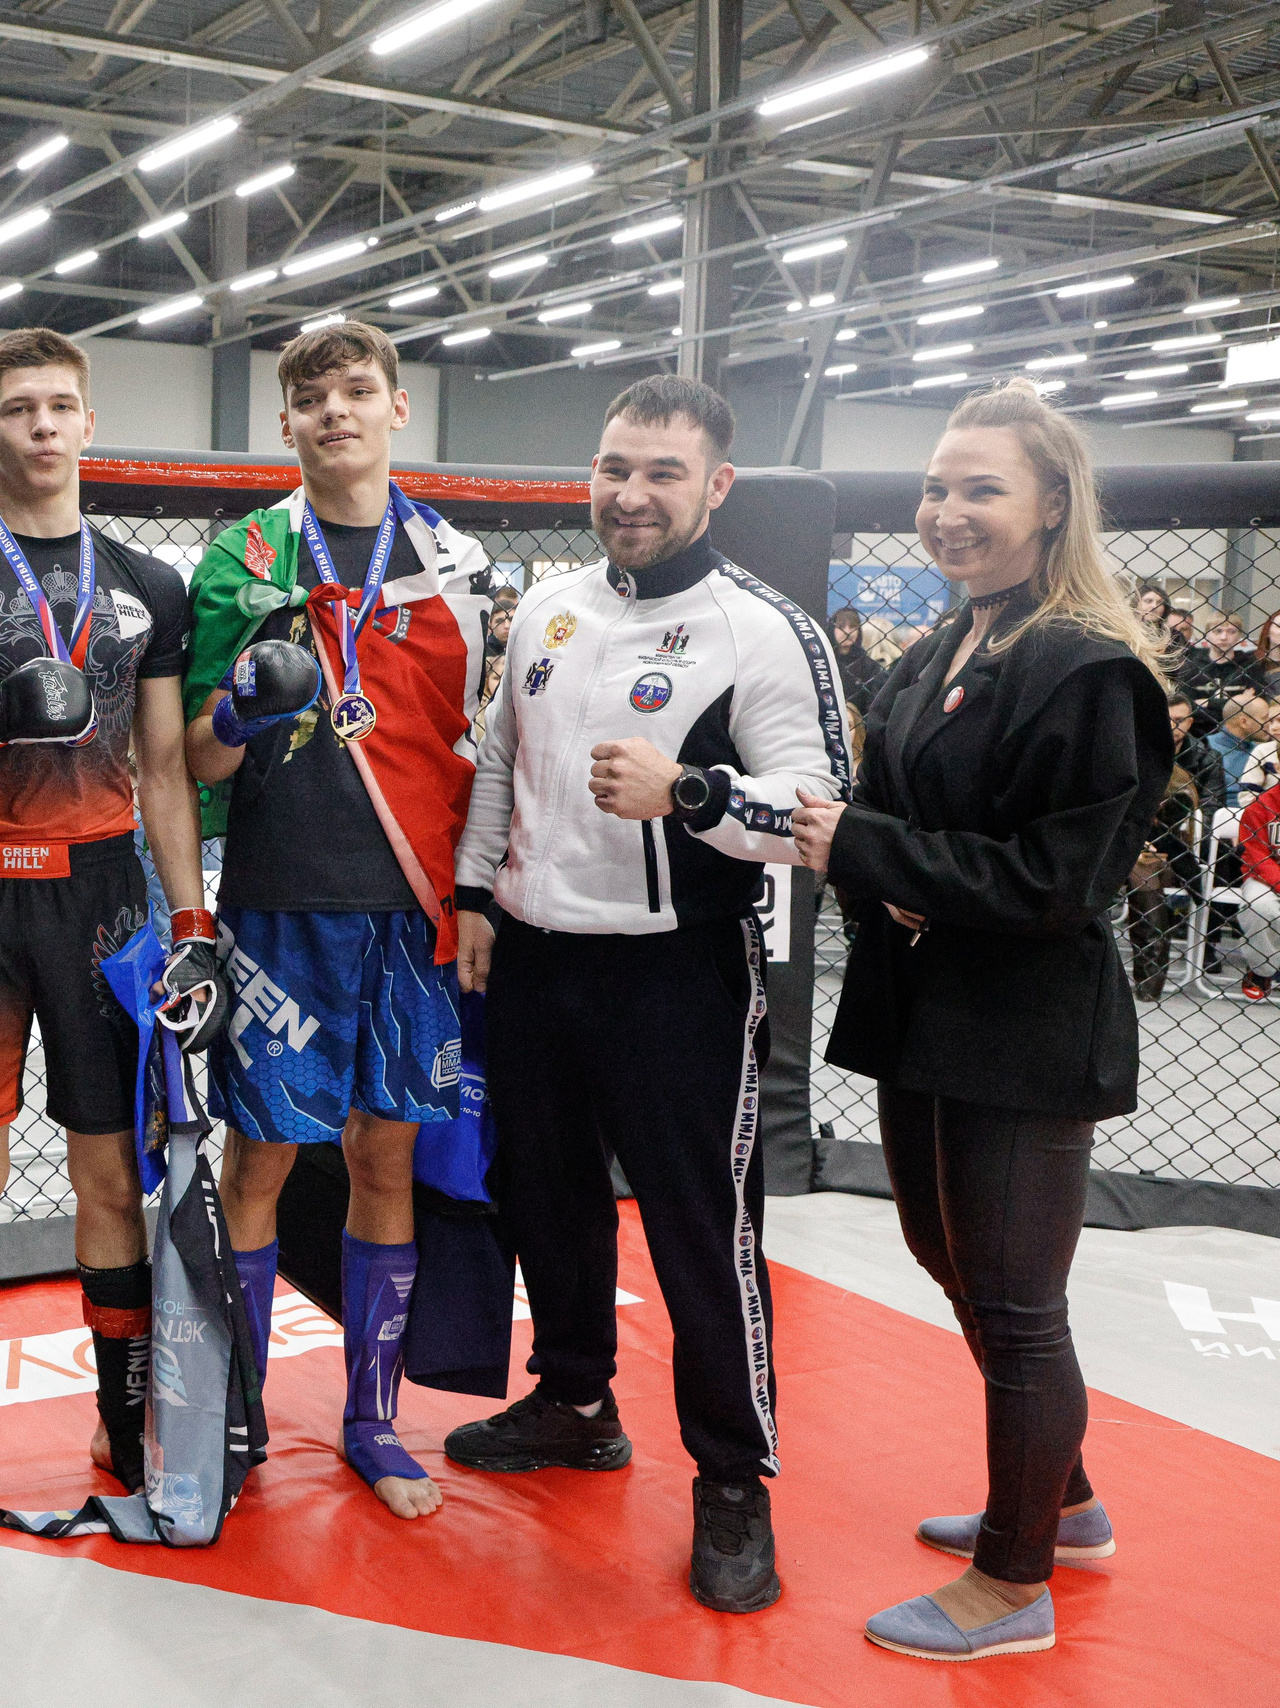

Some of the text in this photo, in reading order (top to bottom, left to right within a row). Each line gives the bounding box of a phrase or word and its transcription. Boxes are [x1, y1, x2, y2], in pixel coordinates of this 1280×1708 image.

[81, 534, 93, 594] АВТОЛЕГИОНЕ
[368, 517, 395, 587] АВТОЛЕГИОНЕ
[16, 562, 38, 592] БИТВА
[316, 552, 335, 584] БИТВА
[754, 588, 784, 602] MMA
[119, 610, 144, 620] HILL
[790, 612, 815, 640] MMA
[813, 658, 831, 690] MMA
[825, 710, 840, 740] MMA
[2, 847, 50, 857] GREEN
[4, 857, 43, 869] HILL
[744, 1063, 757, 1094] MMA
[737, 1112, 755, 1140] MMA
[739, 1249, 752, 1278] MMA
[748, 1294, 762, 1326] MMA
[752, 1341, 766, 1373] MMA
